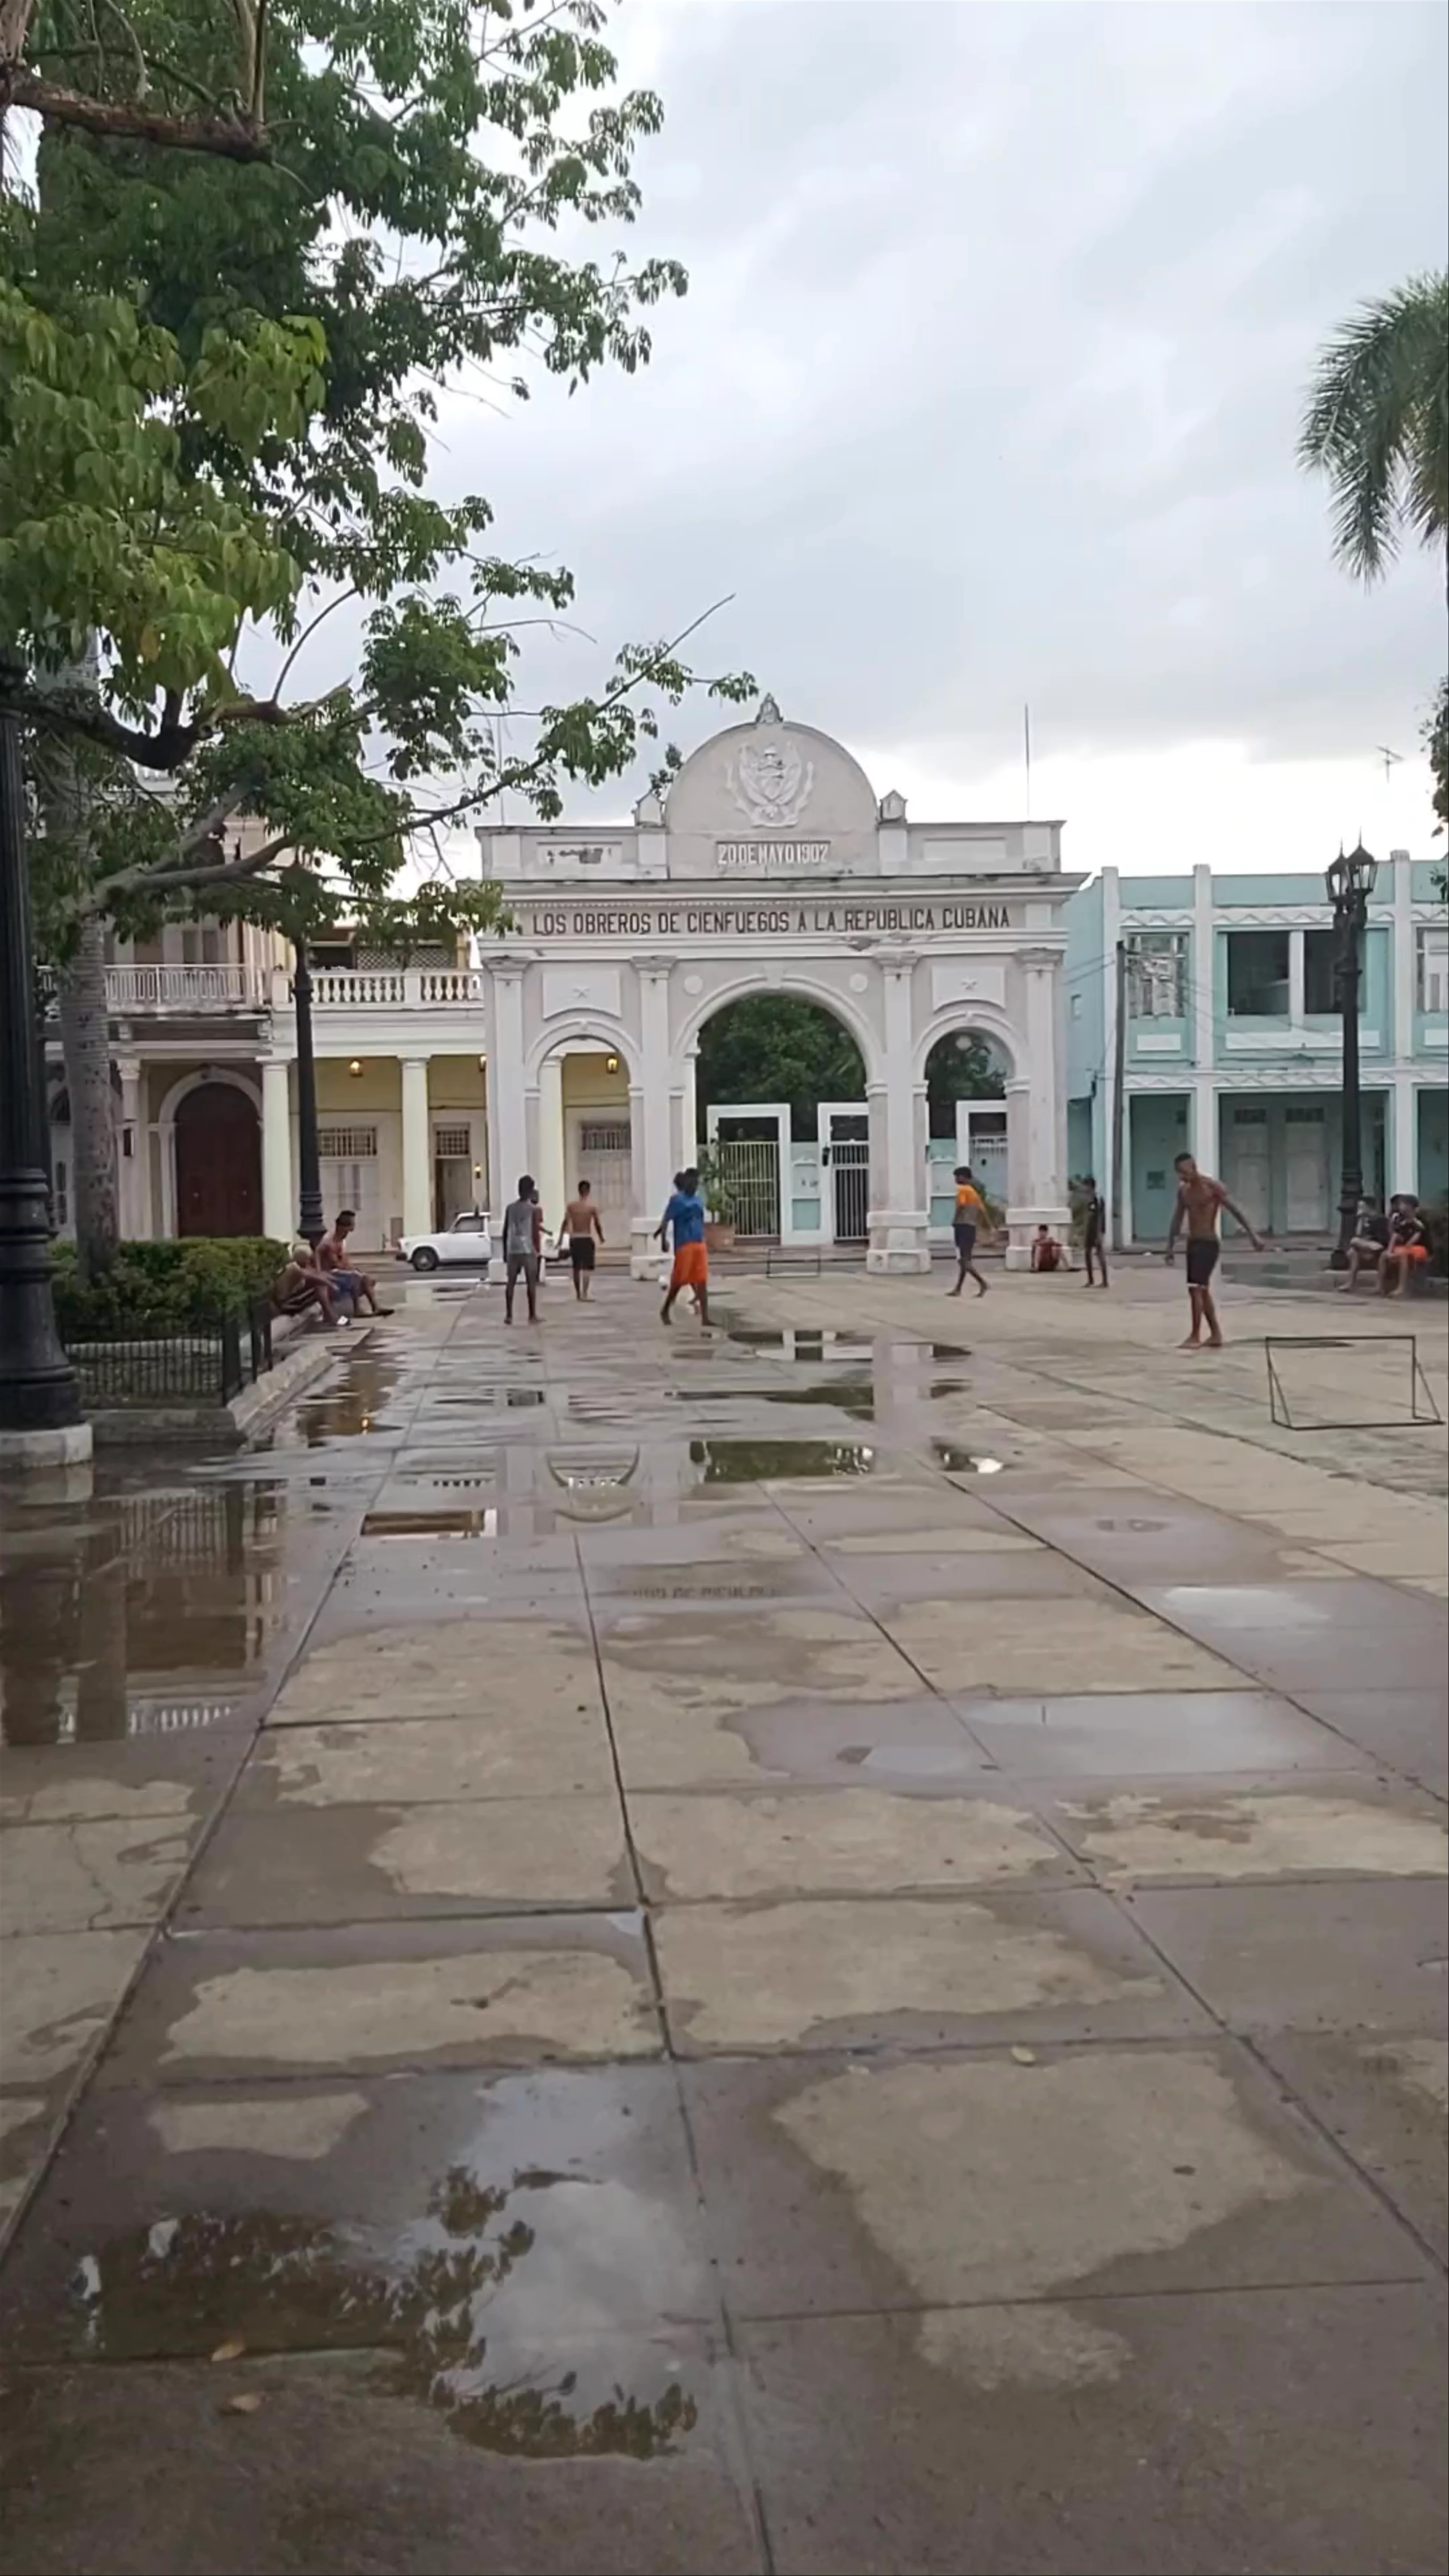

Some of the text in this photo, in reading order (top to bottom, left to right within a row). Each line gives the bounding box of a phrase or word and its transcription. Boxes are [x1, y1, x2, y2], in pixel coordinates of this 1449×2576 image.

[718, 843, 829, 865] 20 DE MAYO 1902
[533, 906, 1010, 935] LOS OBREROS DE CIENFUEGOS A LA REPUBLICA CUBANA
